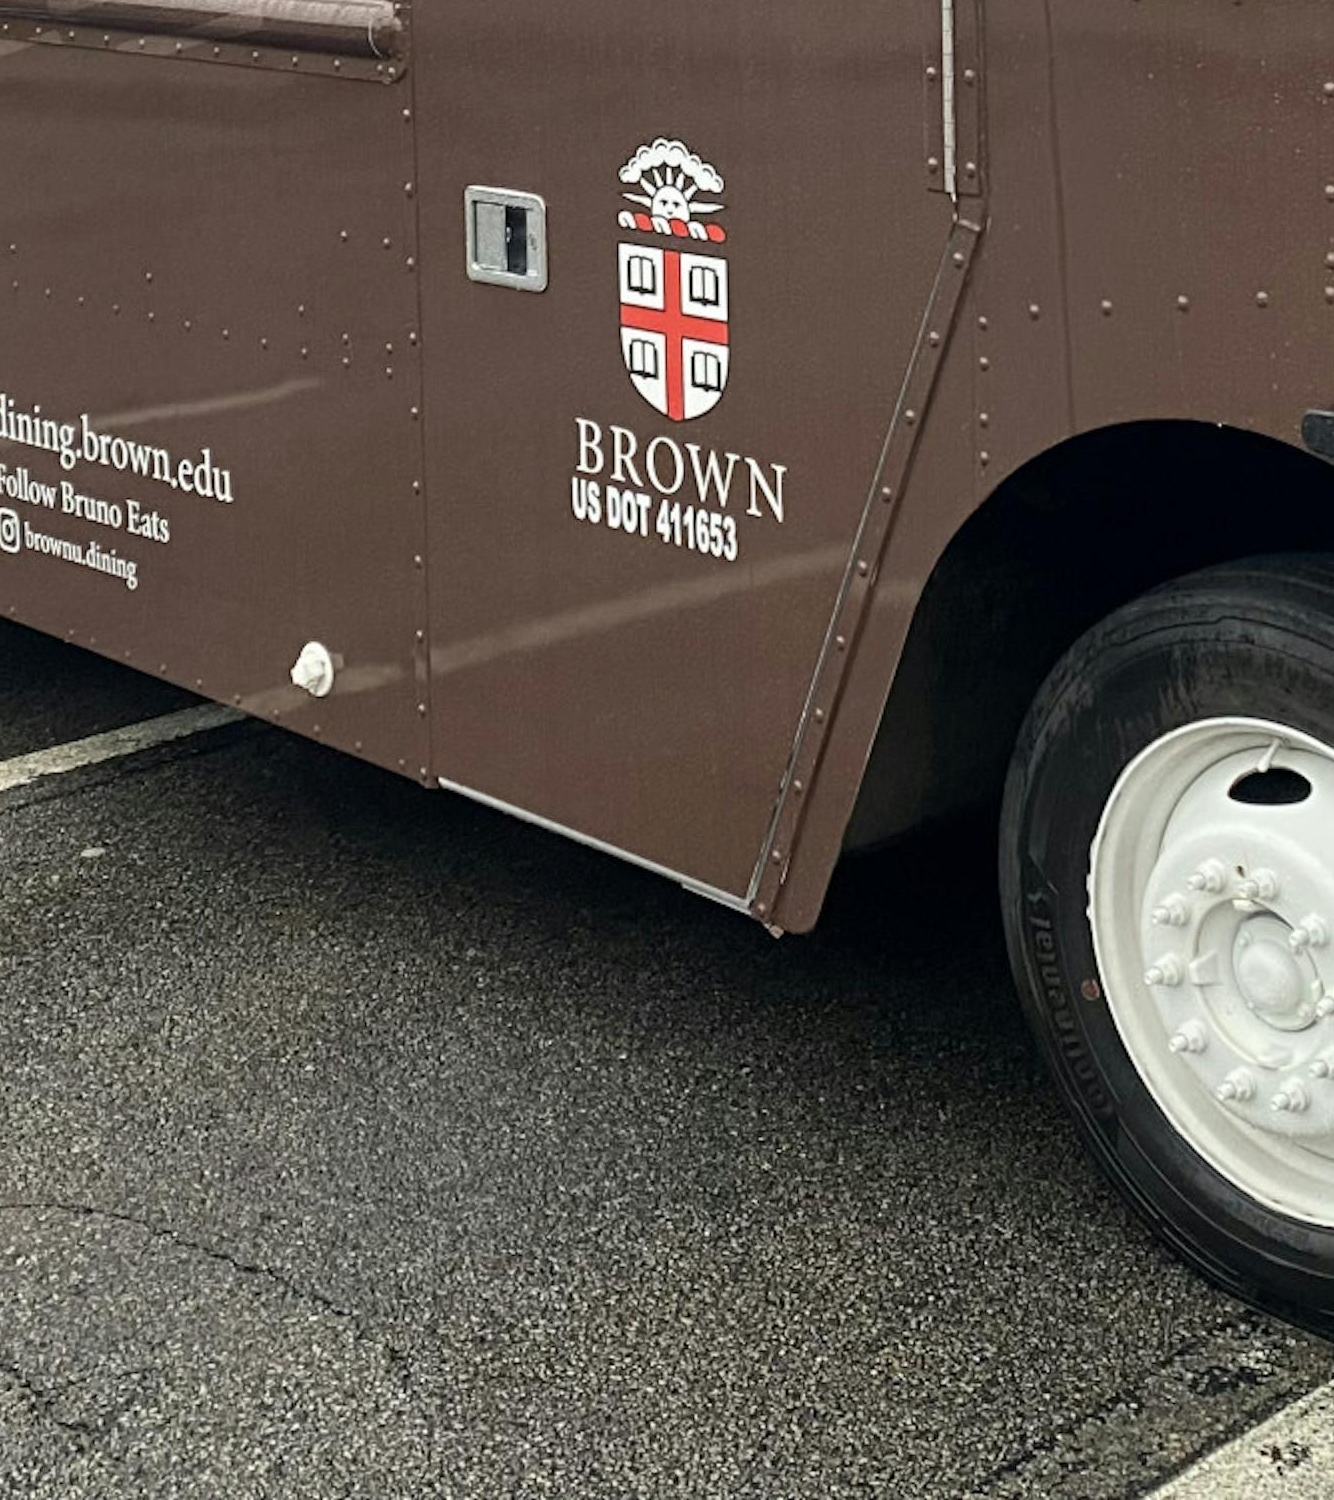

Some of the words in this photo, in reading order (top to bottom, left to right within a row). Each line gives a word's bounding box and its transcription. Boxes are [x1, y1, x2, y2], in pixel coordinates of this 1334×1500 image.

[575, 418, 787, 523] BROWN
[61, 481, 122, 529] Bruno
[126, 500, 169, 543] Eats
[571, 476, 602, 523] US
[606, 485, 651, 537] DOT
[656, 499, 737, 561] 411653
[24, 522, 137, 589] brownu.dining
